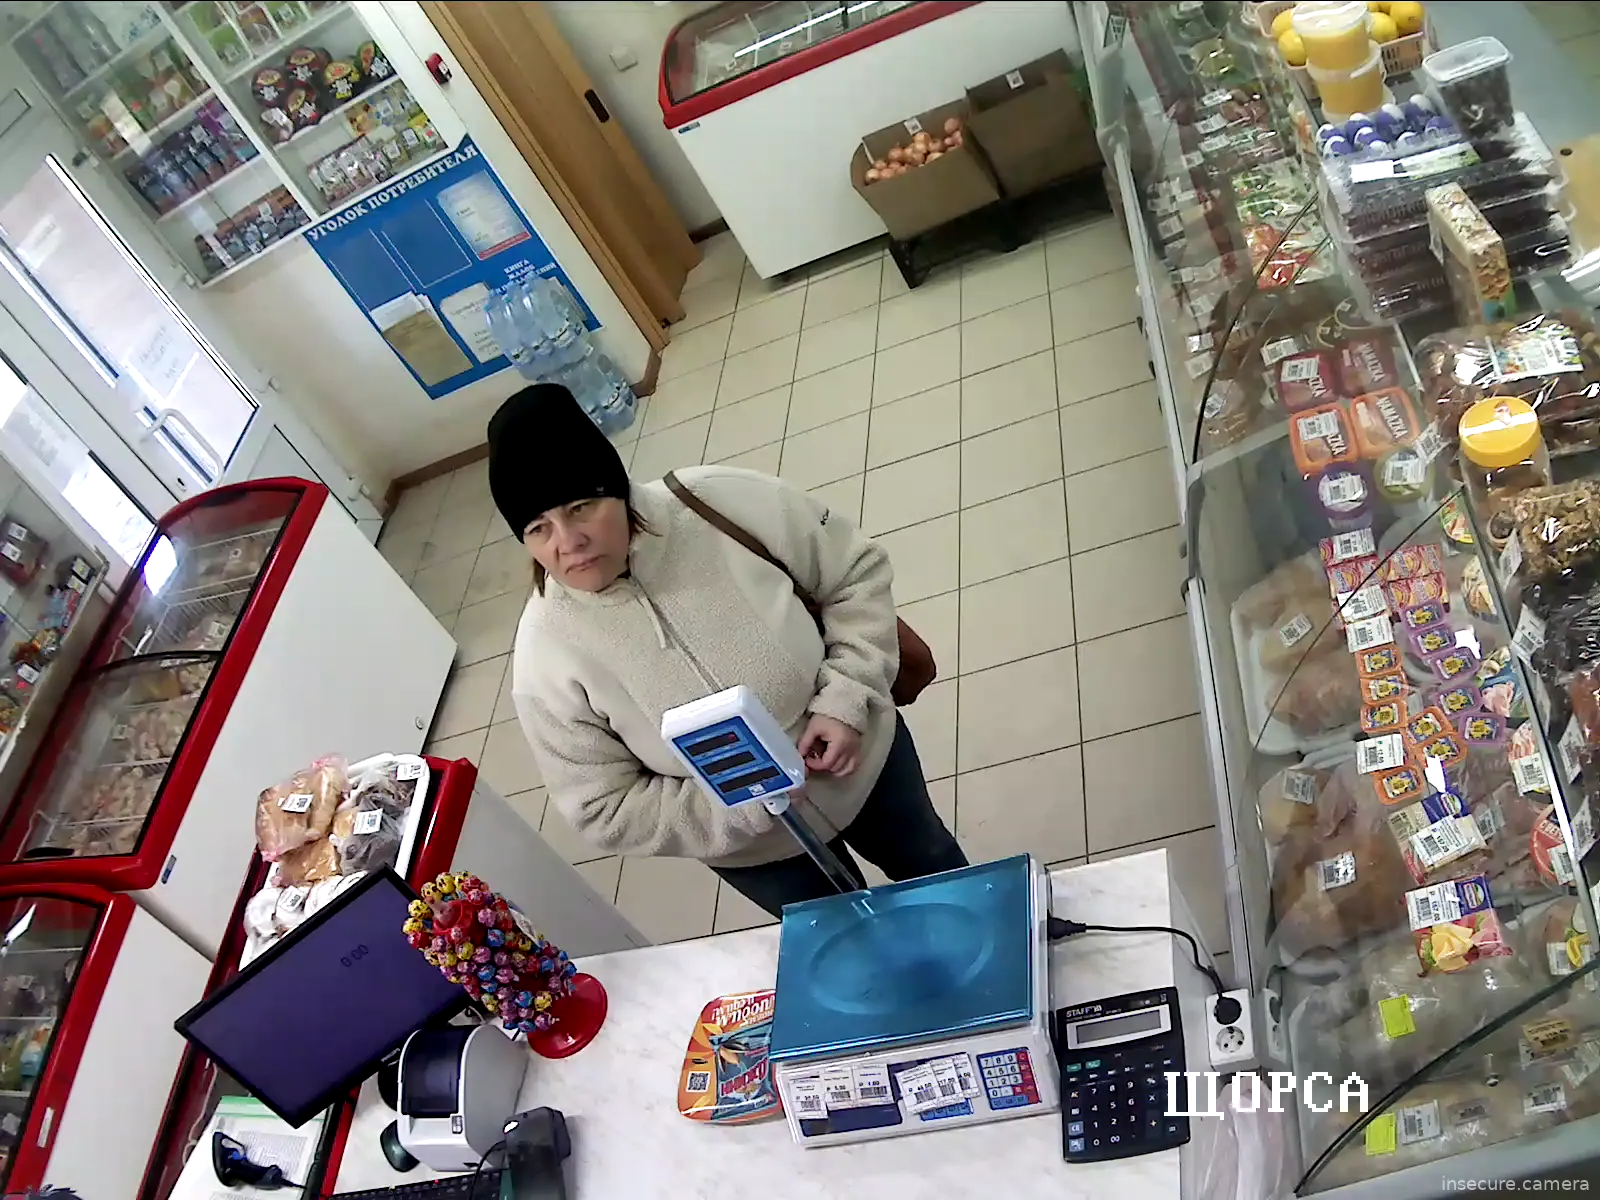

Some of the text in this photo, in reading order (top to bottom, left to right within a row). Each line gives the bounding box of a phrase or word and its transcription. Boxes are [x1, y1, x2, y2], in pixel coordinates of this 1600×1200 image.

[308, 143, 479, 241] УГОЛОК ПОТРЕБИТЕЛЯ
[504, 259, 530, 273] КНИГА
